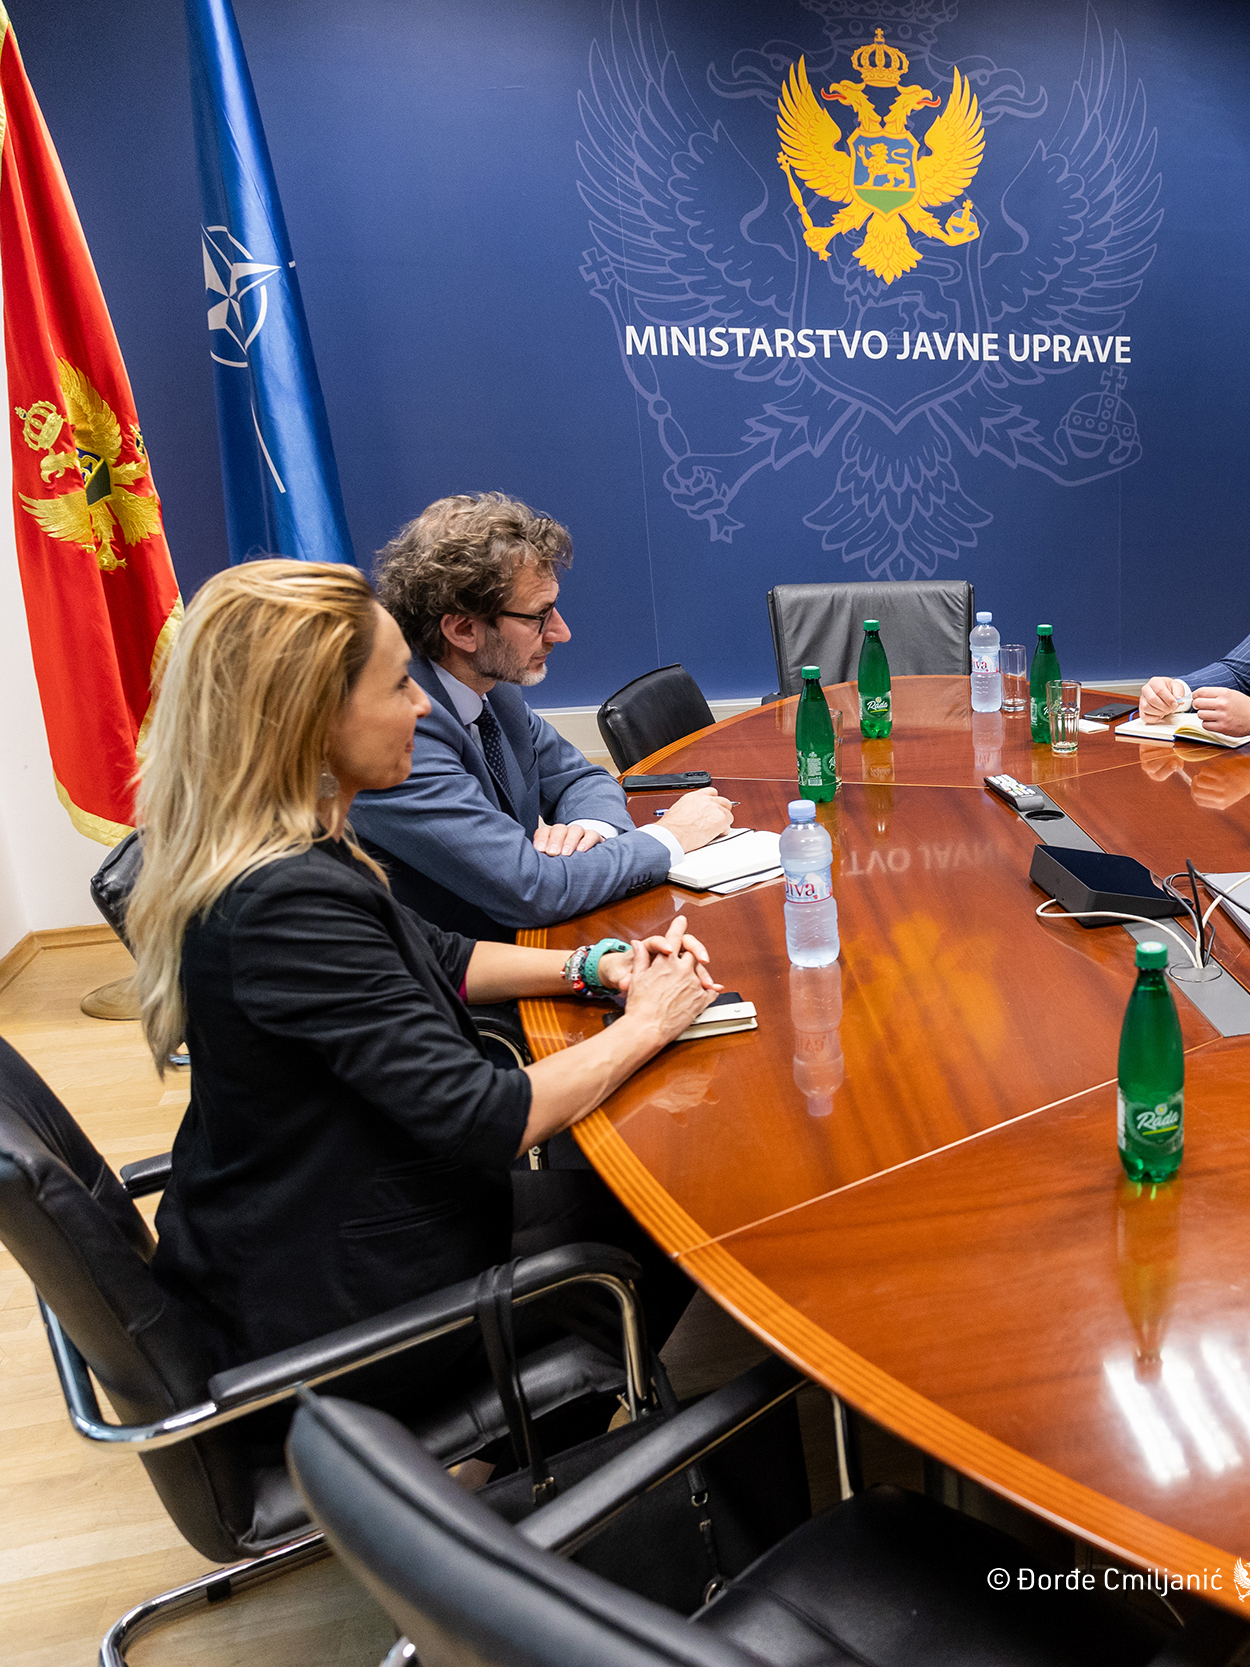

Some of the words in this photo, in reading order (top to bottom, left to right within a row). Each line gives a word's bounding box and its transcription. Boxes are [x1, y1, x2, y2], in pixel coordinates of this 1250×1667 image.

[625, 325, 889, 360] MINISTARSTVO
[896, 331, 1000, 362] JAVNE
[1008, 333, 1132, 364] UPRAVE
[867, 700, 889, 711] Rada
[1136, 1110, 1180, 1131] Rada
